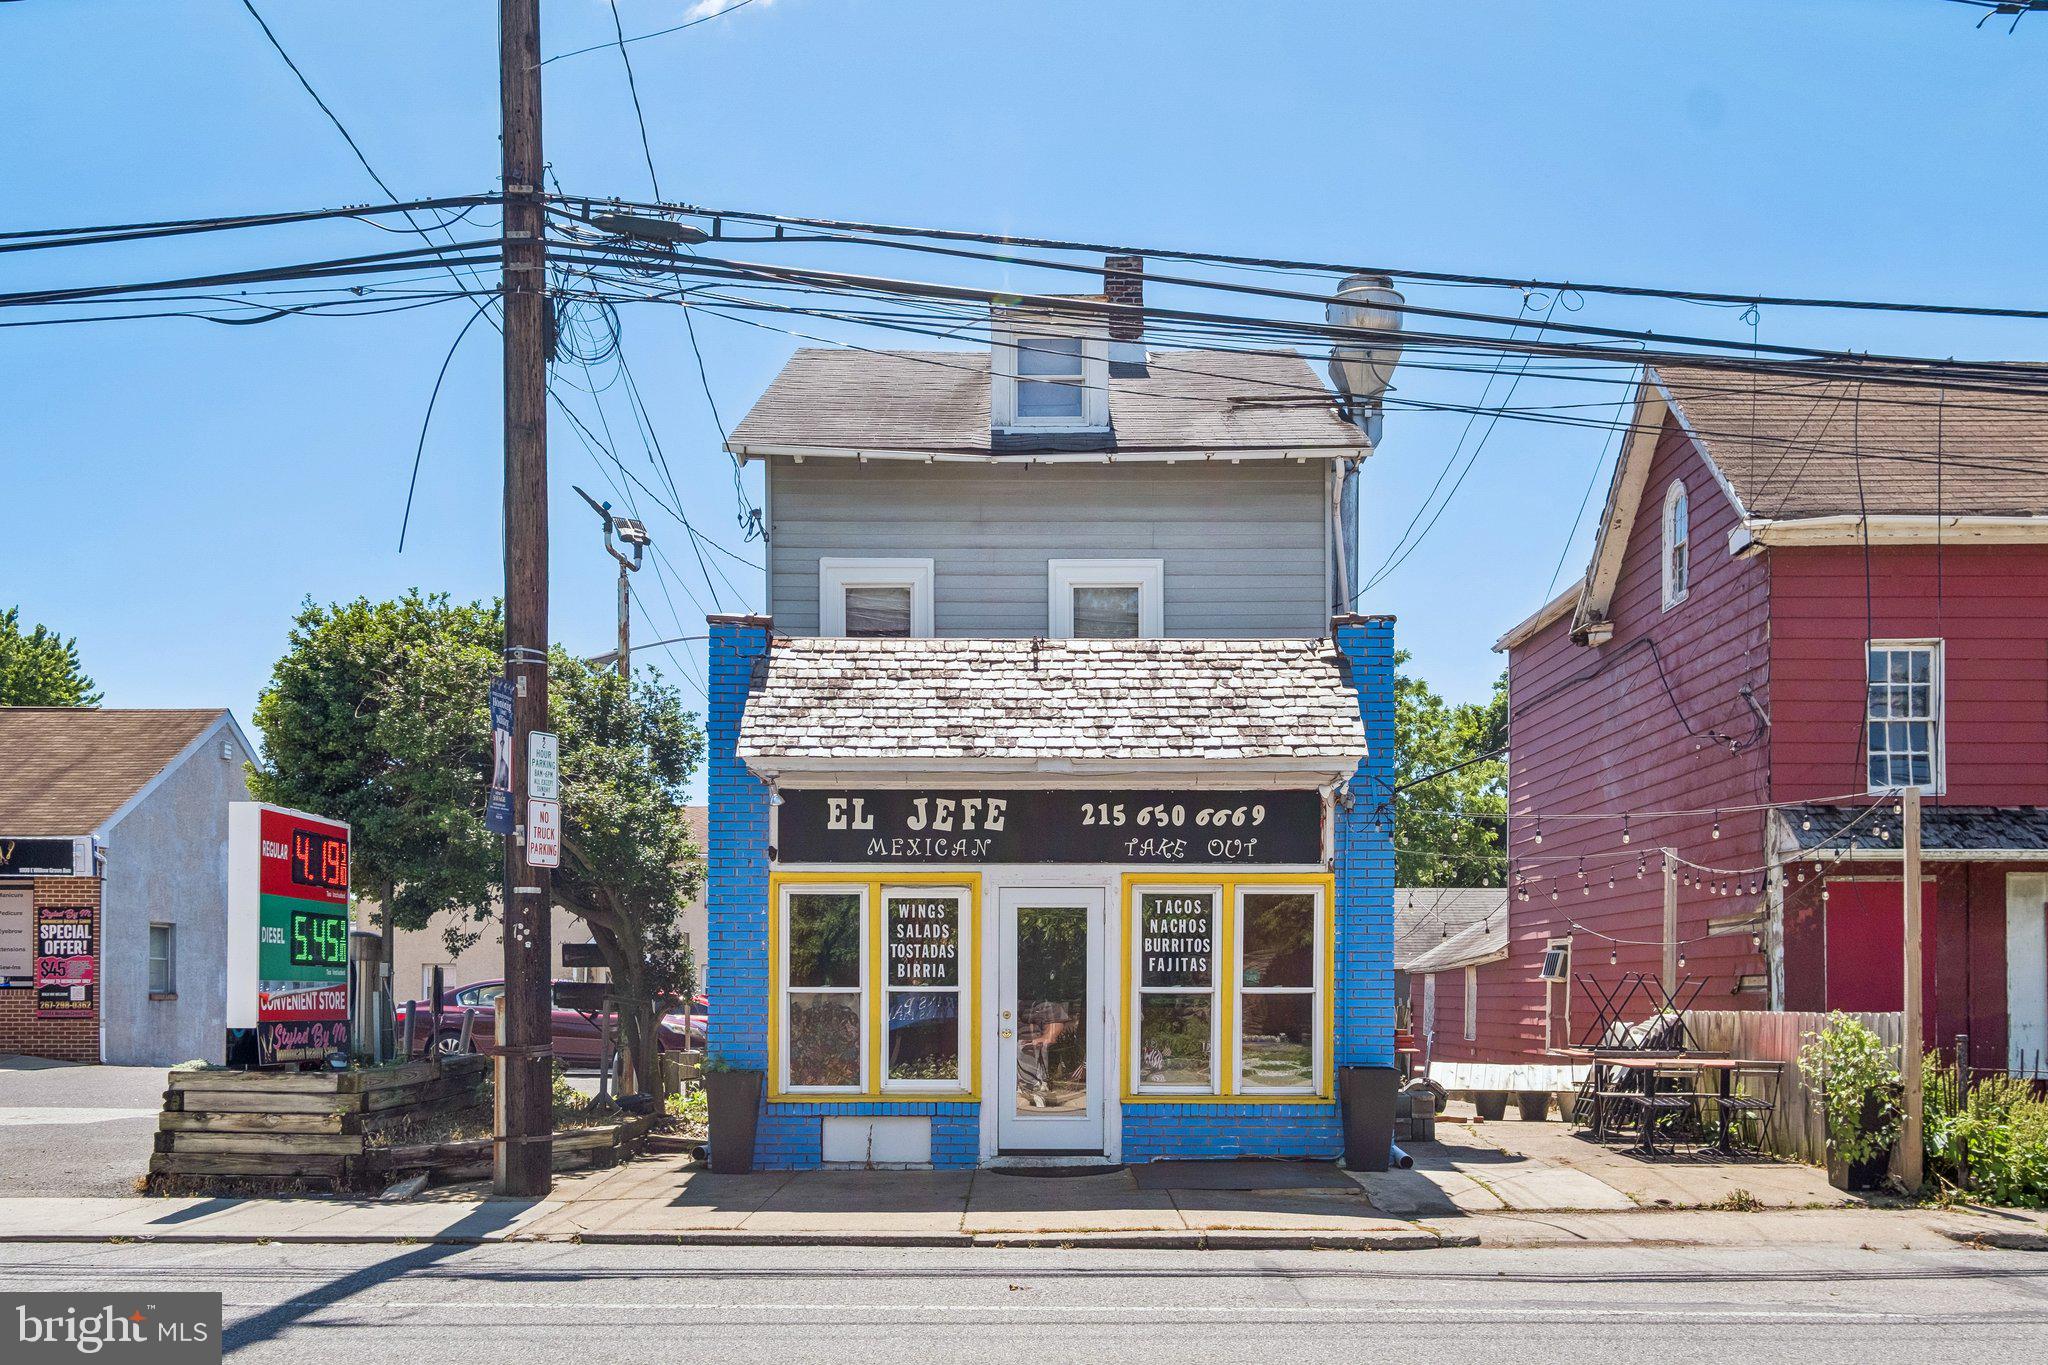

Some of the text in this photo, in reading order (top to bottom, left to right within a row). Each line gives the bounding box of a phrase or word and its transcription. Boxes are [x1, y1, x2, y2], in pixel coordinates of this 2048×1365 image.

[541, 740, 547, 749] 2
[536, 749, 552, 759] HOUR
[531, 758, 556, 770] PARKING
[540, 811, 550, 824] NO
[827, 797, 1008, 832] EL JEFE
[1081, 803, 1266, 827] 215 650 6669
[533, 826, 555, 840] TRUCK
[262, 839, 289, 860] REGULAR
[530, 842, 557, 856] PARKING
[867, 838, 992, 857] MEXICAN
[1125, 837, 1258, 859] TAKE OUT
[898, 904, 945, 919] WINGS
[1154, 899, 1202, 914] TACOS
[40, 924, 92, 939] SPECIAL
[896, 923, 950, 938] SALADS
[1150, 918, 1206, 933] NACHOS
[261, 926, 285, 944] DIESEL
[295, 916, 339, 962] 5.45
[1144, 938, 1211, 953] BURRITOS
[44, 940, 88, 955] OFFER!
[890, 944, 955, 958] TOSTADAS
[41, 959, 66, 978] $45
[897, 963, 946, 978] BIRRIA
[1149, 957, 1207, 972] FAJITAS
[319, 991, 346, 1010] STORE
[273, 1022, 347, 1050] Styled By M
